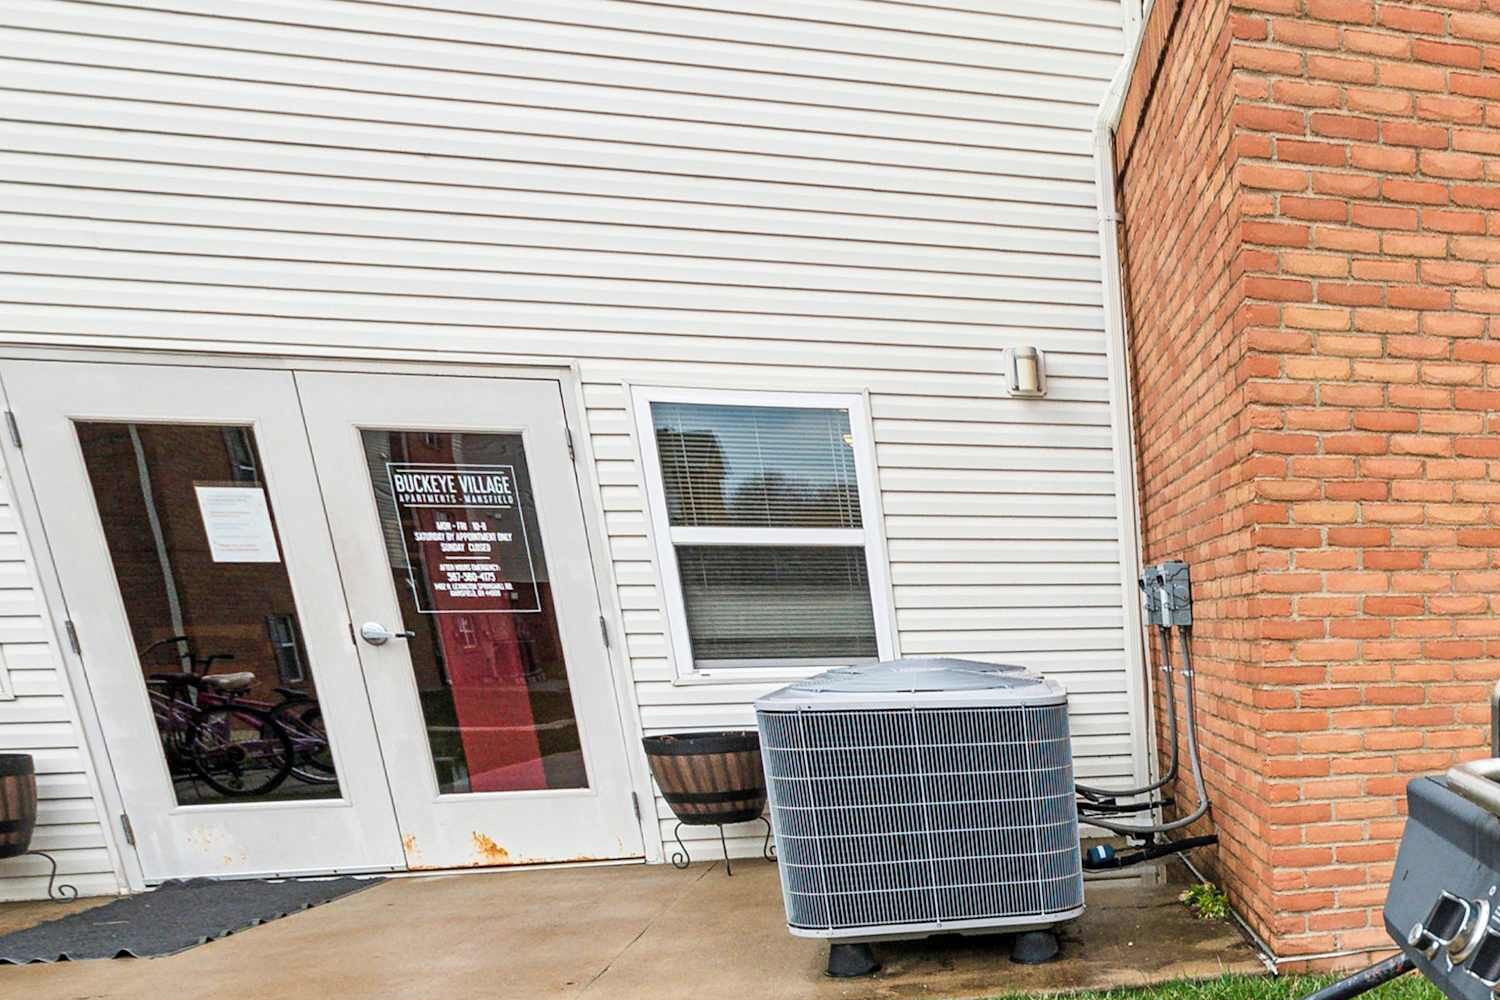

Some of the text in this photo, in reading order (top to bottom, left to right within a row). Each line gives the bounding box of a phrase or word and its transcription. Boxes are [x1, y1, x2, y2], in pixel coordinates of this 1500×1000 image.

[395, 475, 511, 494] BUCKEYE VILLAGE
[399, 494, 456, 503] APARTMENTS
[464, 495, 514, 504] MANSFIELD
